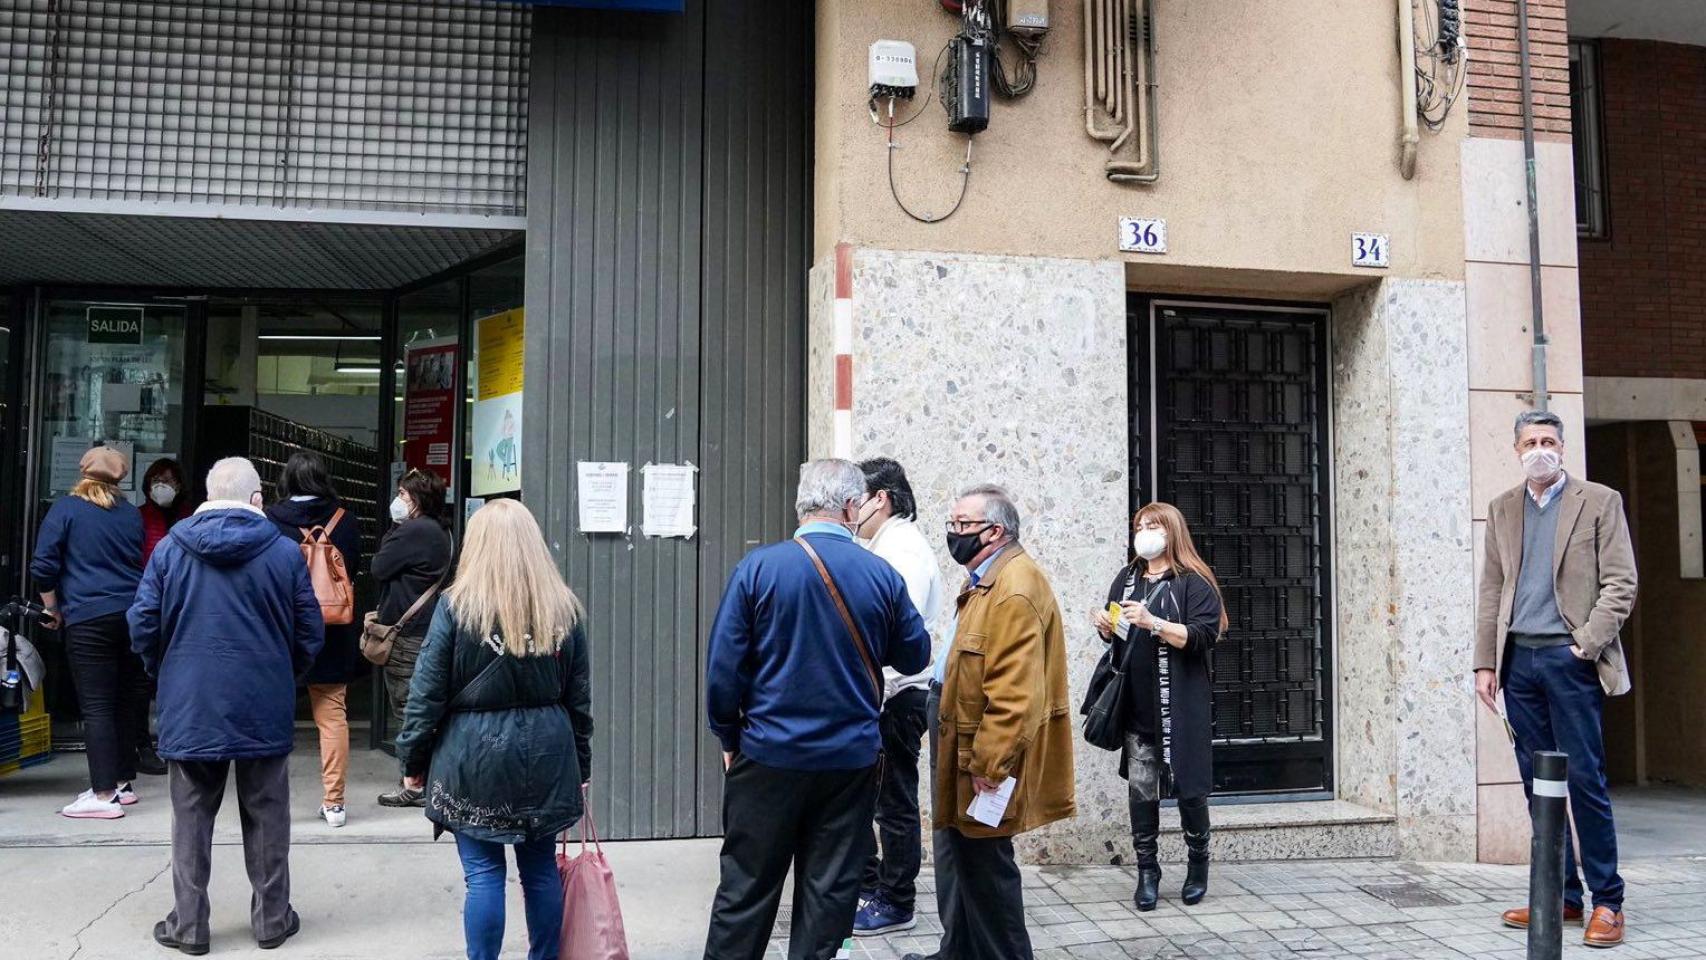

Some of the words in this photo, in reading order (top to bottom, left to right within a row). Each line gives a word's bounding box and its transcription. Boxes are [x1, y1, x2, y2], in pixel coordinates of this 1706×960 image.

[1128, 222, 1158, 247] 36
[1354, 237, 1380, 261] 34
[90, 319, 139, 332] SALIDA
